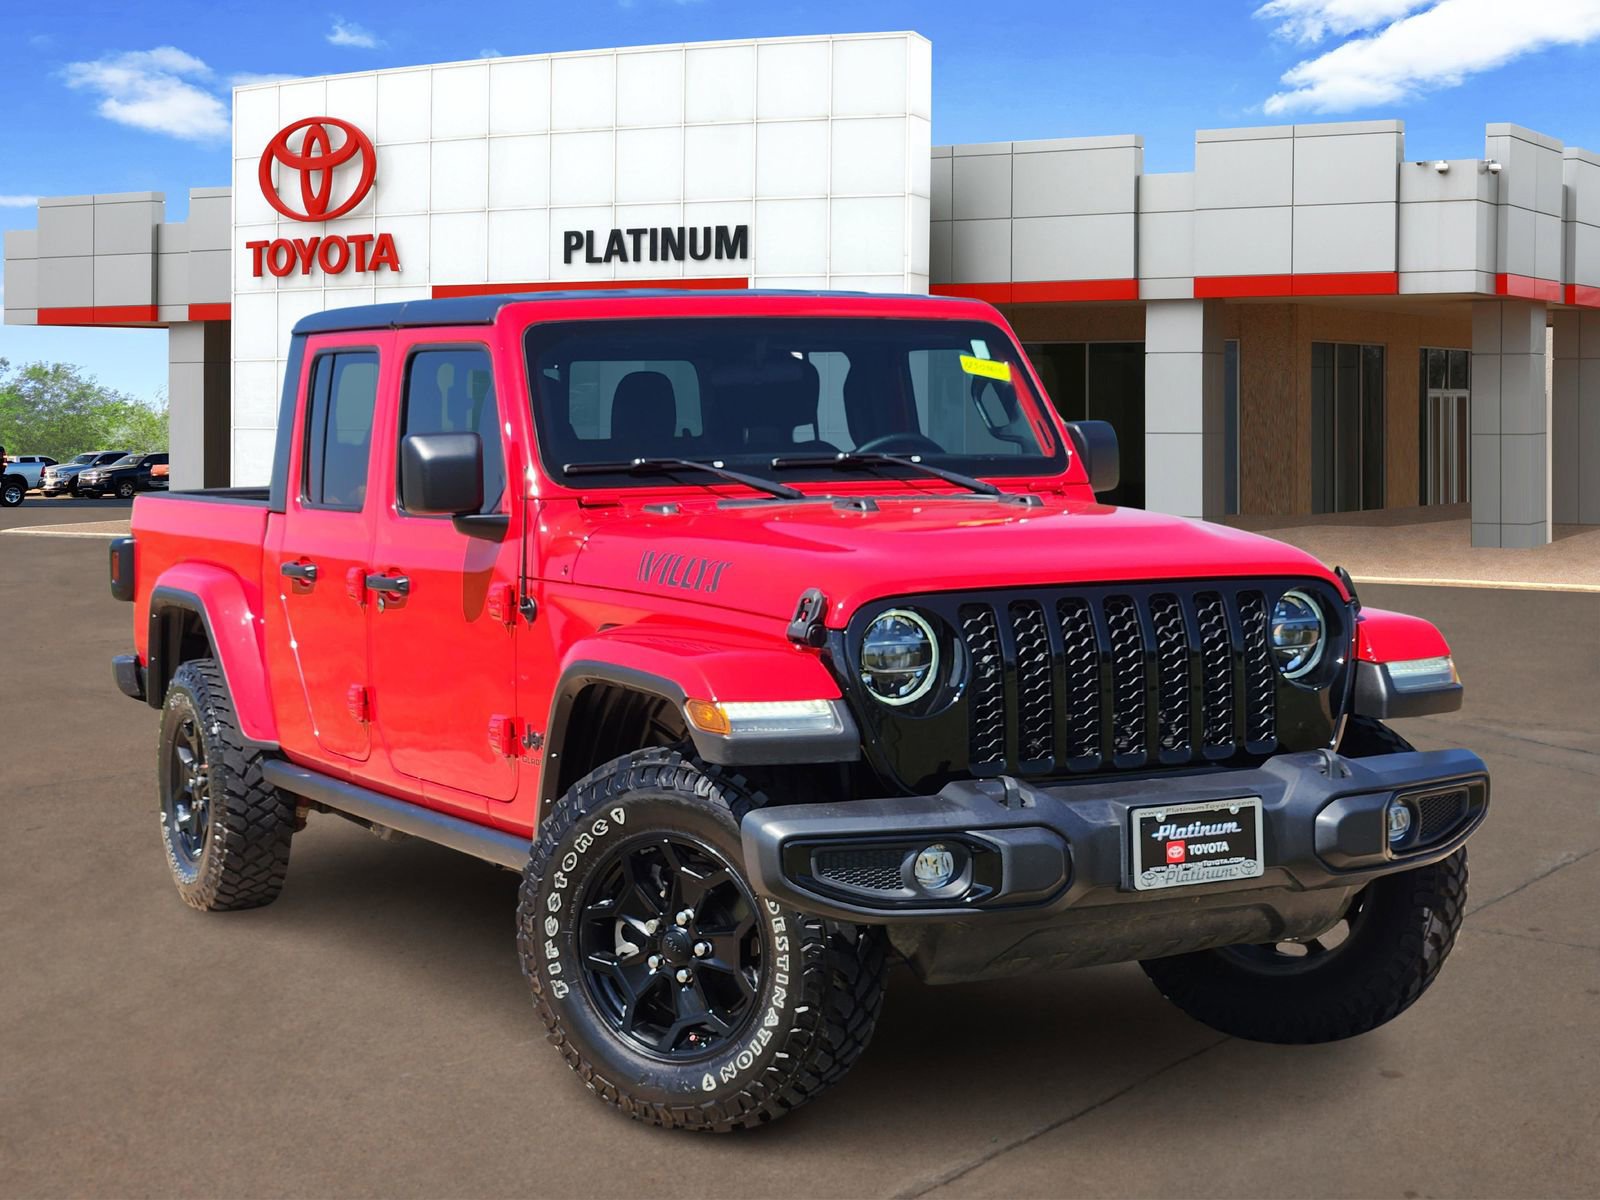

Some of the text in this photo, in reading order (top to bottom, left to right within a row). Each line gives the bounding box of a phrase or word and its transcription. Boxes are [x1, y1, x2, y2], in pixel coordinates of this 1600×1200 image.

[246, 233, 401, 277] TOYOTA
[563, 225, 748, 264] PLATINUM
[637, 551, 733, 592] WILLYS
[1151, 821, 1242, 840] Platinum
[1188, 841, 1229, 856] TOYOTA
[1165, 866, 1239, 885] Platinum
[544, 819, 609, 999] Firestone
